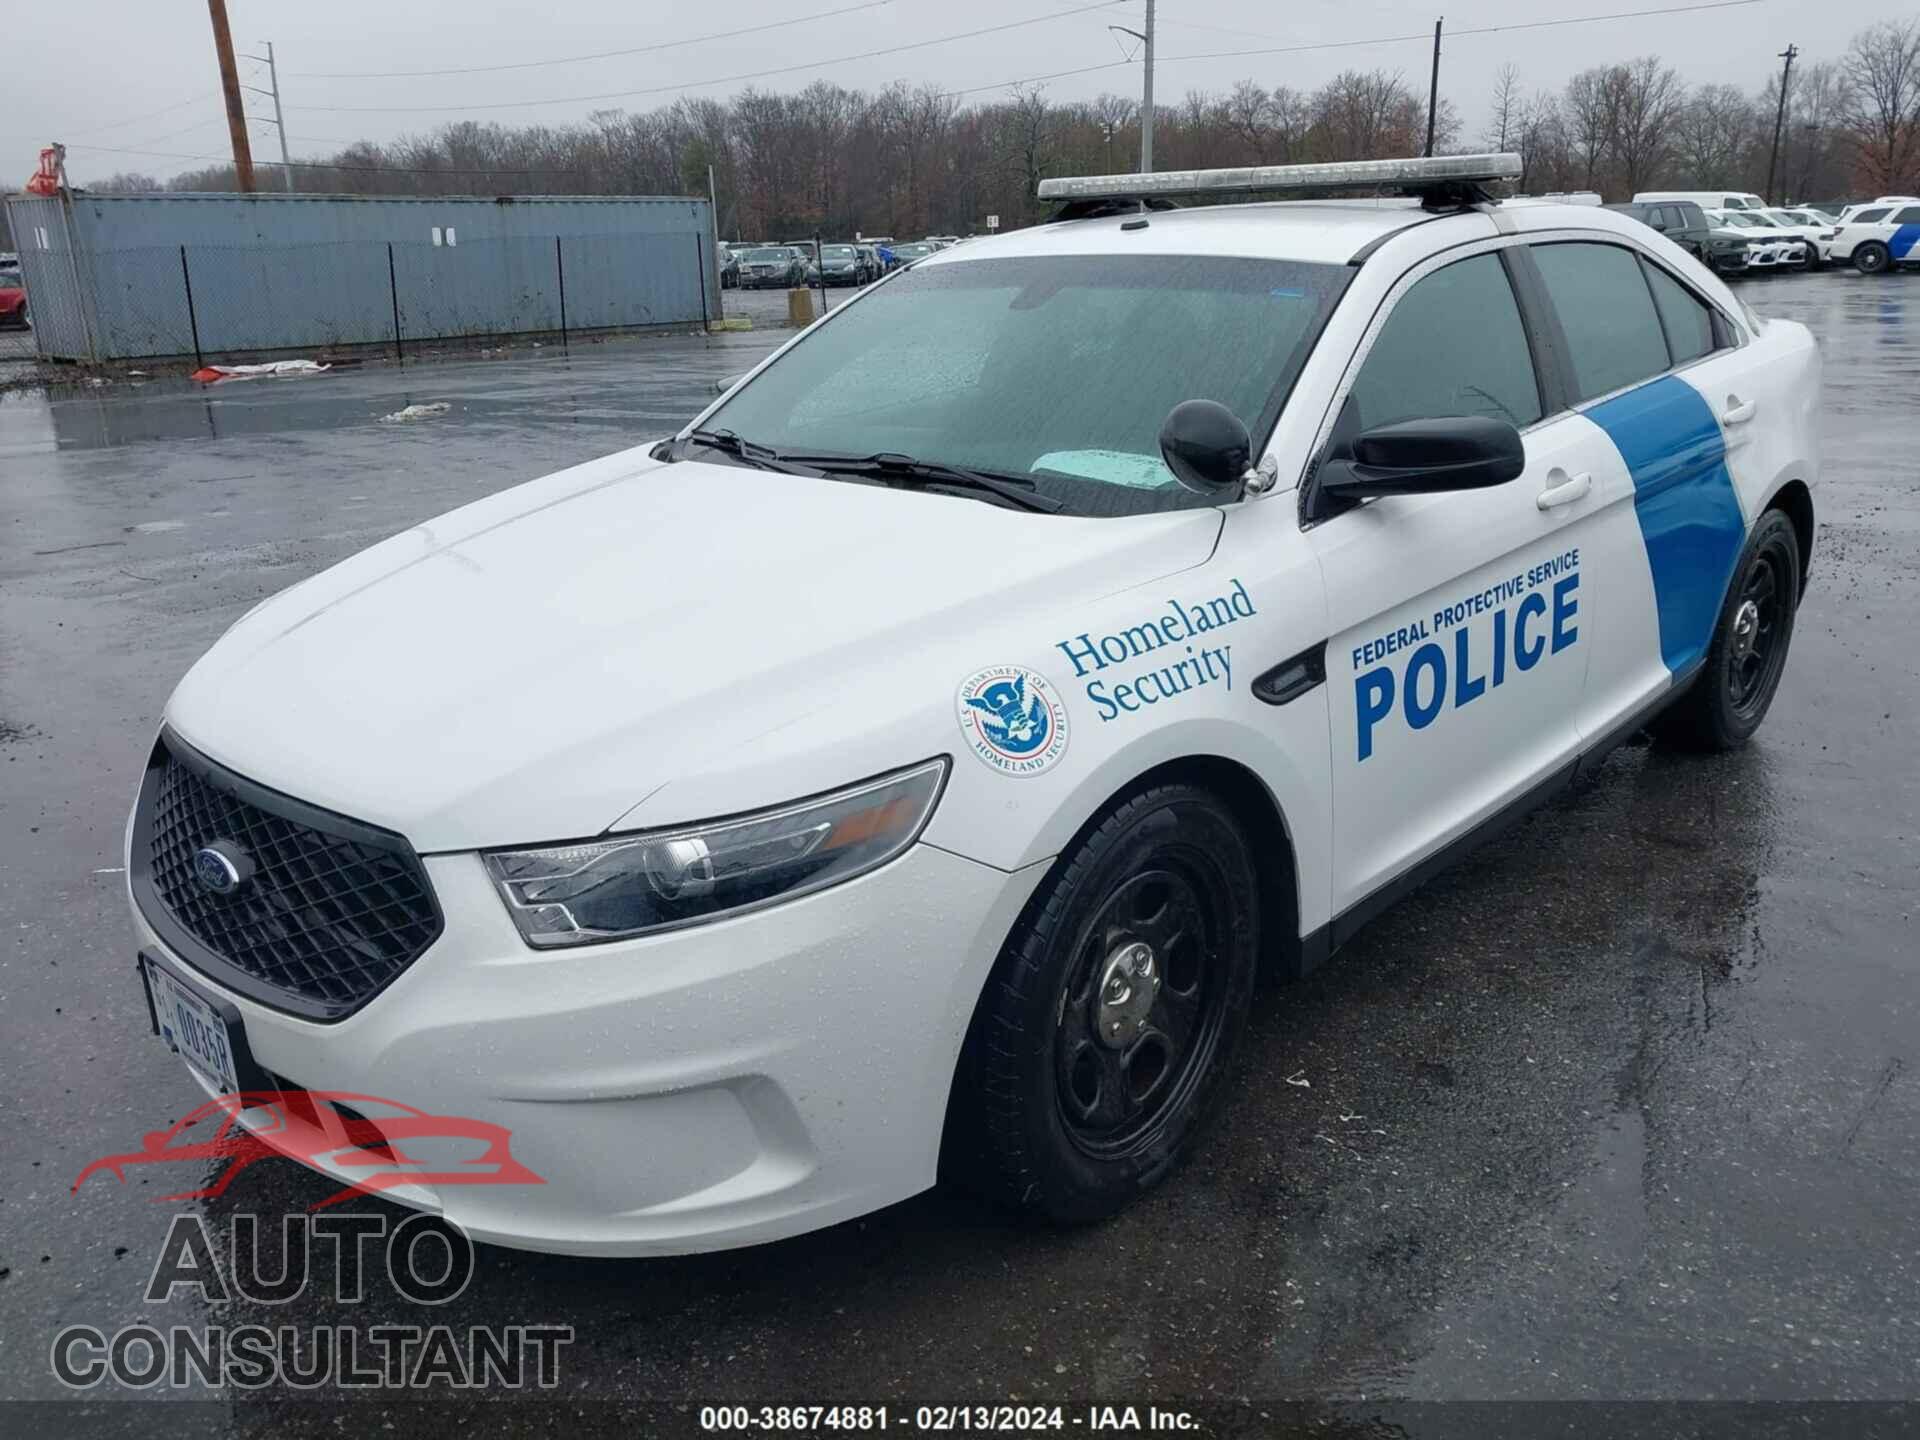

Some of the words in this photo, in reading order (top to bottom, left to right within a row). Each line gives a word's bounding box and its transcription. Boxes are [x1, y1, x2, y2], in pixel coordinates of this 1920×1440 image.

[1056, 578, 1257, 678] Homeland
[1352, 620, 1429, 670] FEDERAL
[1434, 574, 1523, 632] PROTECTIVE
[1527, 548, 1580, 588] SERVICE
[961, 667, 1029, 698] DEPARTMENT
[1032, 676, 1048, 690] OF
[1086, 645, 1232, 723] Security
[1355, 572, 1580, 763] POLICE
[975, 741, 1045, 772] HOMELAND
[1046, 703, 1065, 760] SECURITY
